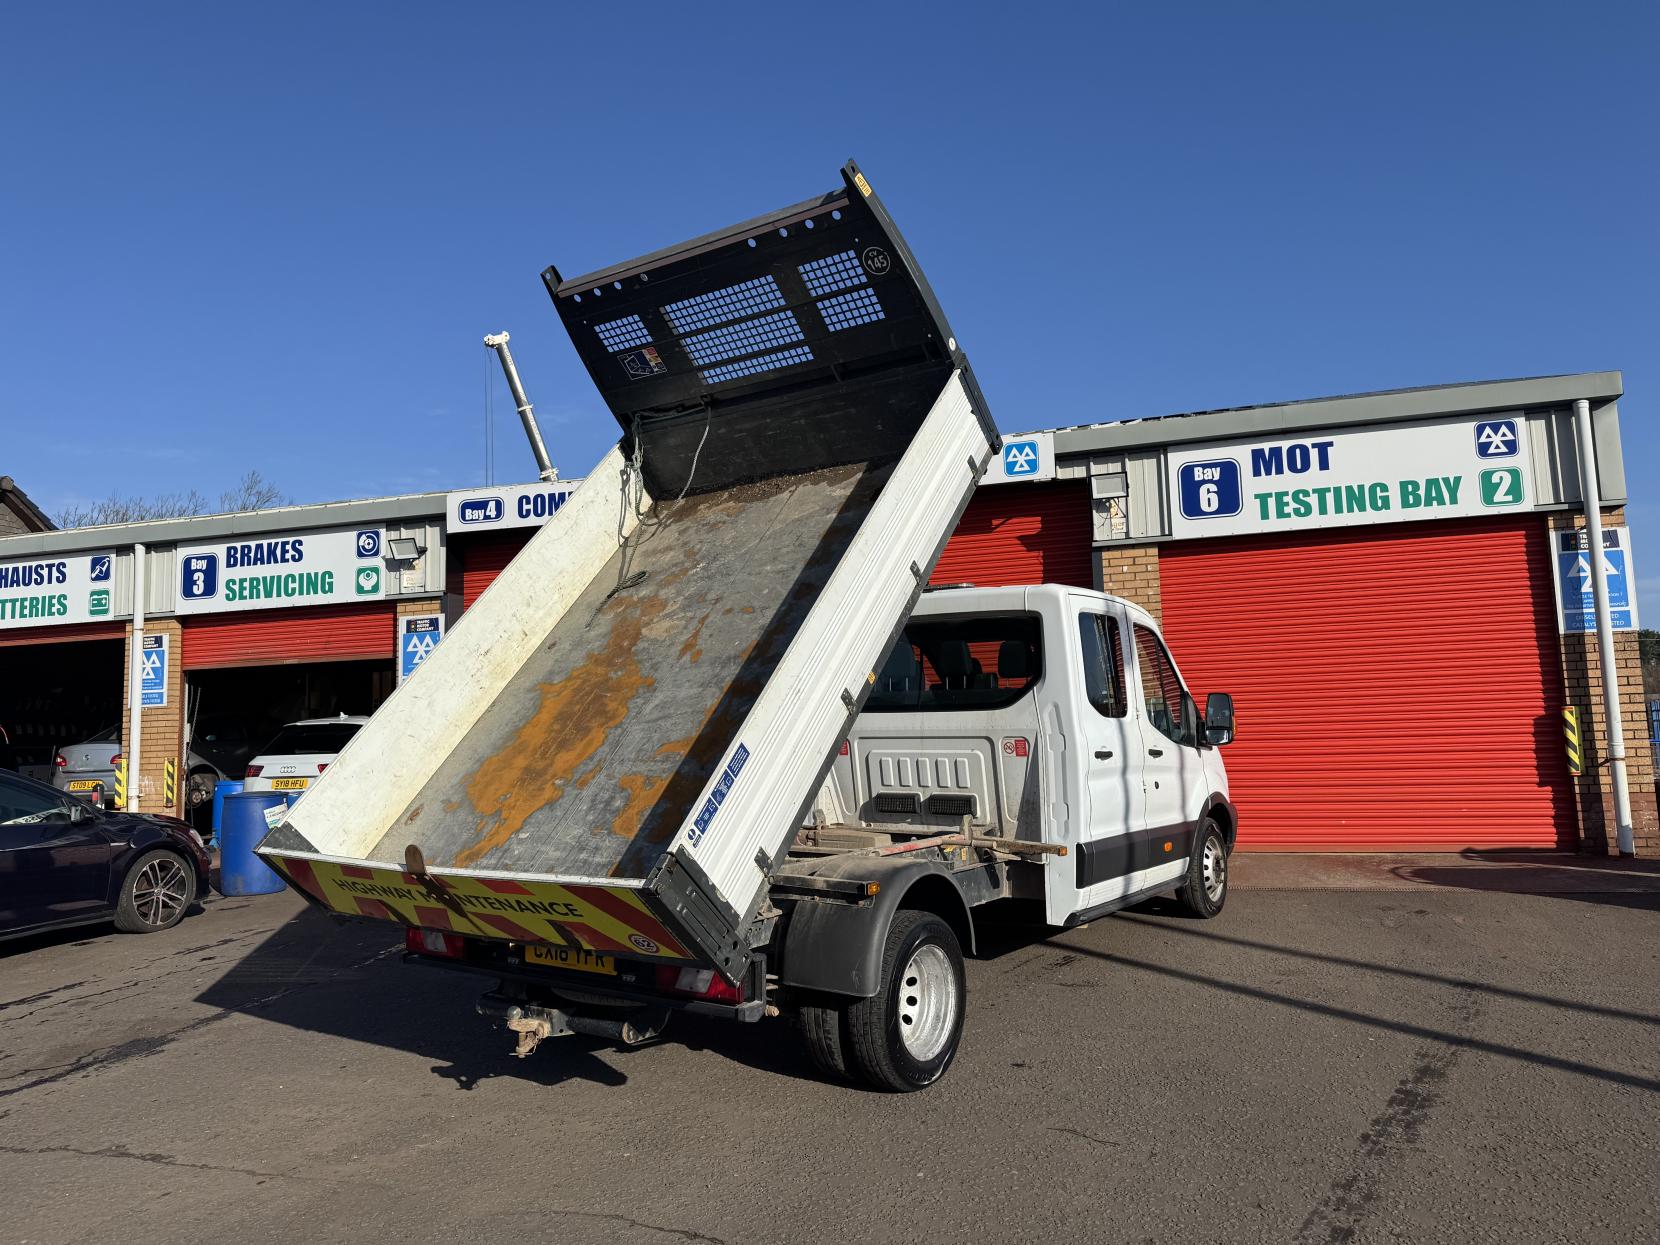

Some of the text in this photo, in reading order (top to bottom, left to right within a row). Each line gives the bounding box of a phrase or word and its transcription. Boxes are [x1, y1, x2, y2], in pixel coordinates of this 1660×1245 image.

[867, 255, 887, 270] 145
[1251, 441, 1334, 478] MOT
[1194, 466, 1220, 481] Bay
[1491, 471, 1513, 502] 2
[465, 500, 497, 520] Bay 4
[517, 491, 573, 519] COM
[1200, 483, 1219, 513] 6
[1254, 476, 1462, 521] TESTING BAY
[190, 559, 207, 570] Bay
[225, 539, 304, 568] BRAKES
[0, 562, 67, 588] HAUSTS
[192, 571, 205, 595] 3
[224, 570, 334, 602] SERVICING
[275, 779, 304, 788] SY18 HFU
[332, 878, 416, 902] HIGHWAY
